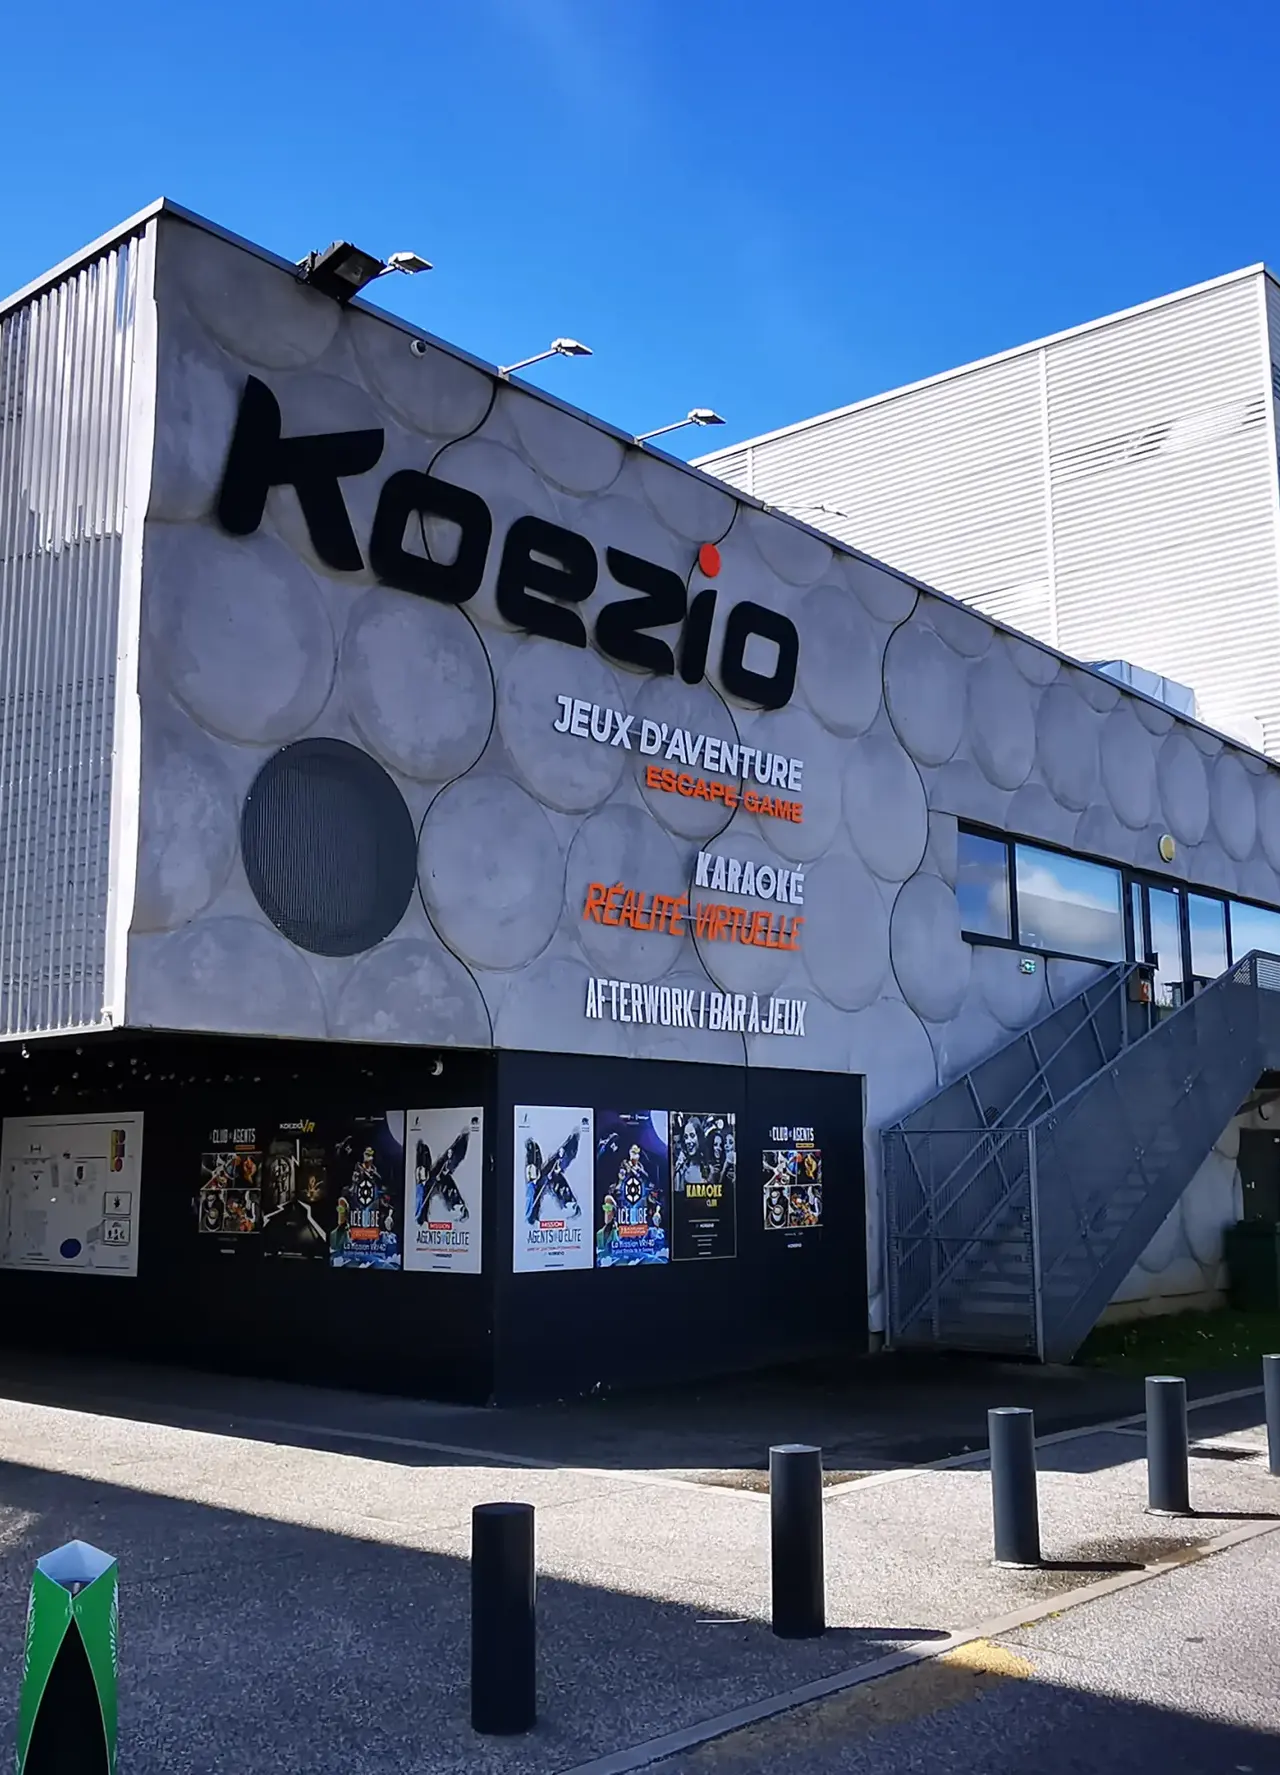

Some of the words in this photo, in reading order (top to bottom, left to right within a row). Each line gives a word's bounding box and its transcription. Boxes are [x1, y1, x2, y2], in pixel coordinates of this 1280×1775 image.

[553, 695, 634, 750] JEUX
[639, 718, 804, 792] D'AVENTURE
[645, 765, 737, 808] ESCAPE
[743, 790, 804, 823] GAME
[695, 851, 805, 905] KARAOKÉ
[583, 882, 688, 936] RÉALITÉ
[695, 902, 806, 951] VIRTUELLE
[586, 977, 695, 1028] AFTERWORK
[708, 992, 745, 1032] BAR
[747, 991, 759, 1034] À
[761, 997, 807, 1037] JEUX
[686, 1184, 722, 1198] KARAOKE
